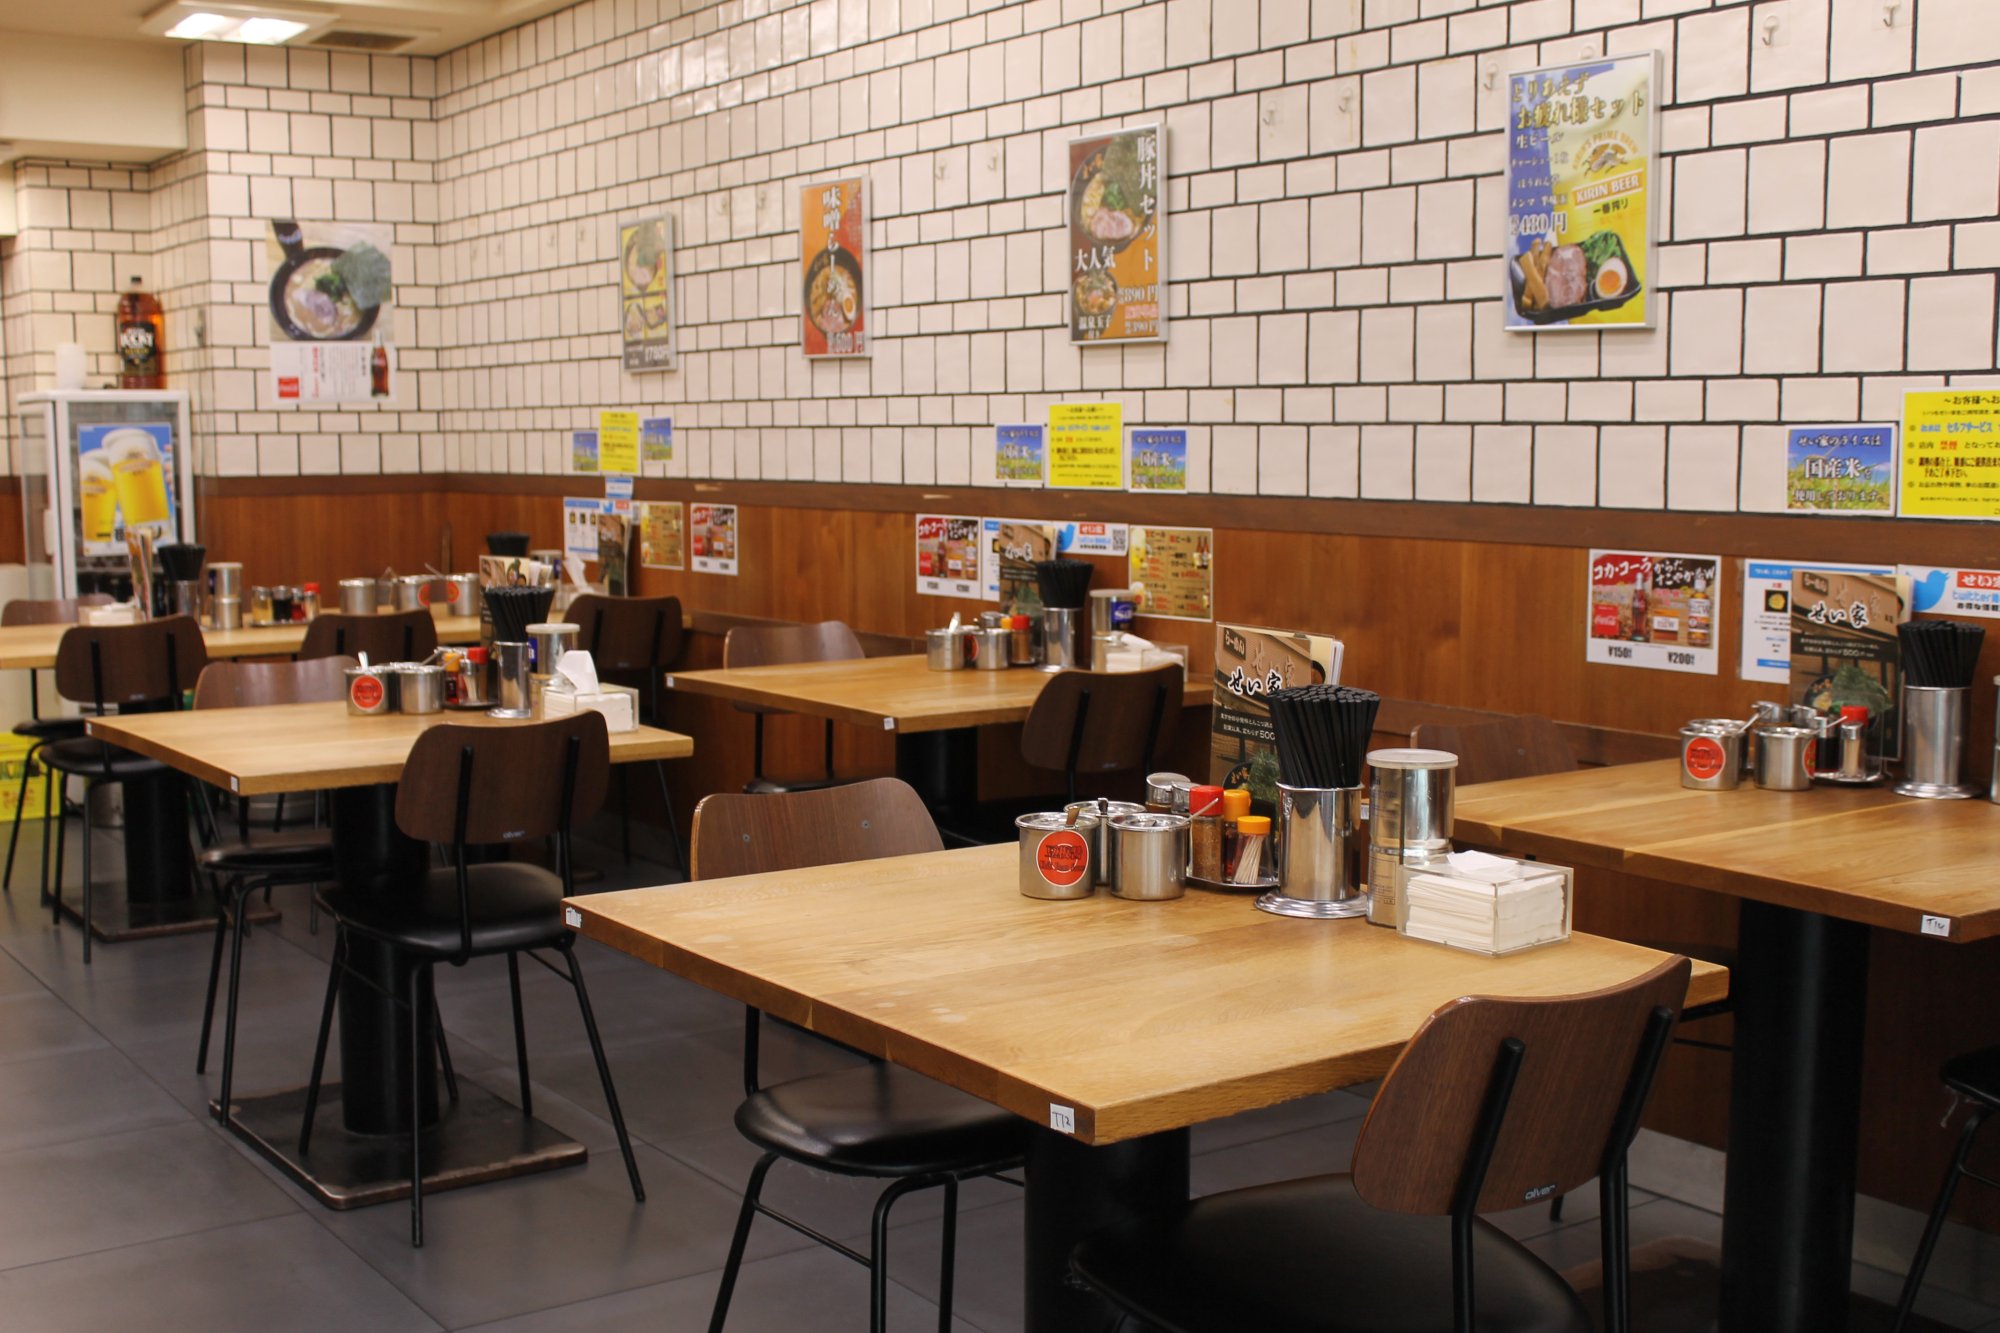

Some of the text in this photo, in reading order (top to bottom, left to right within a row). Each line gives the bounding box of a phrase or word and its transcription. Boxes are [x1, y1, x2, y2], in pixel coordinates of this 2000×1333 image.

[1517, 90, 1644, 129] お疲れ様セット
[1576, 174, 1640, 204] KIRIN BEER
[1074, 245, 1117, 272] 大人気
[1594, 557, 1651, 580] コカ・コーラ
[1808, 601, 1869, 628] せい家
[1225, 631, 1245, 655] らーめん
[1052, 1111, 1072, 1128] T12
